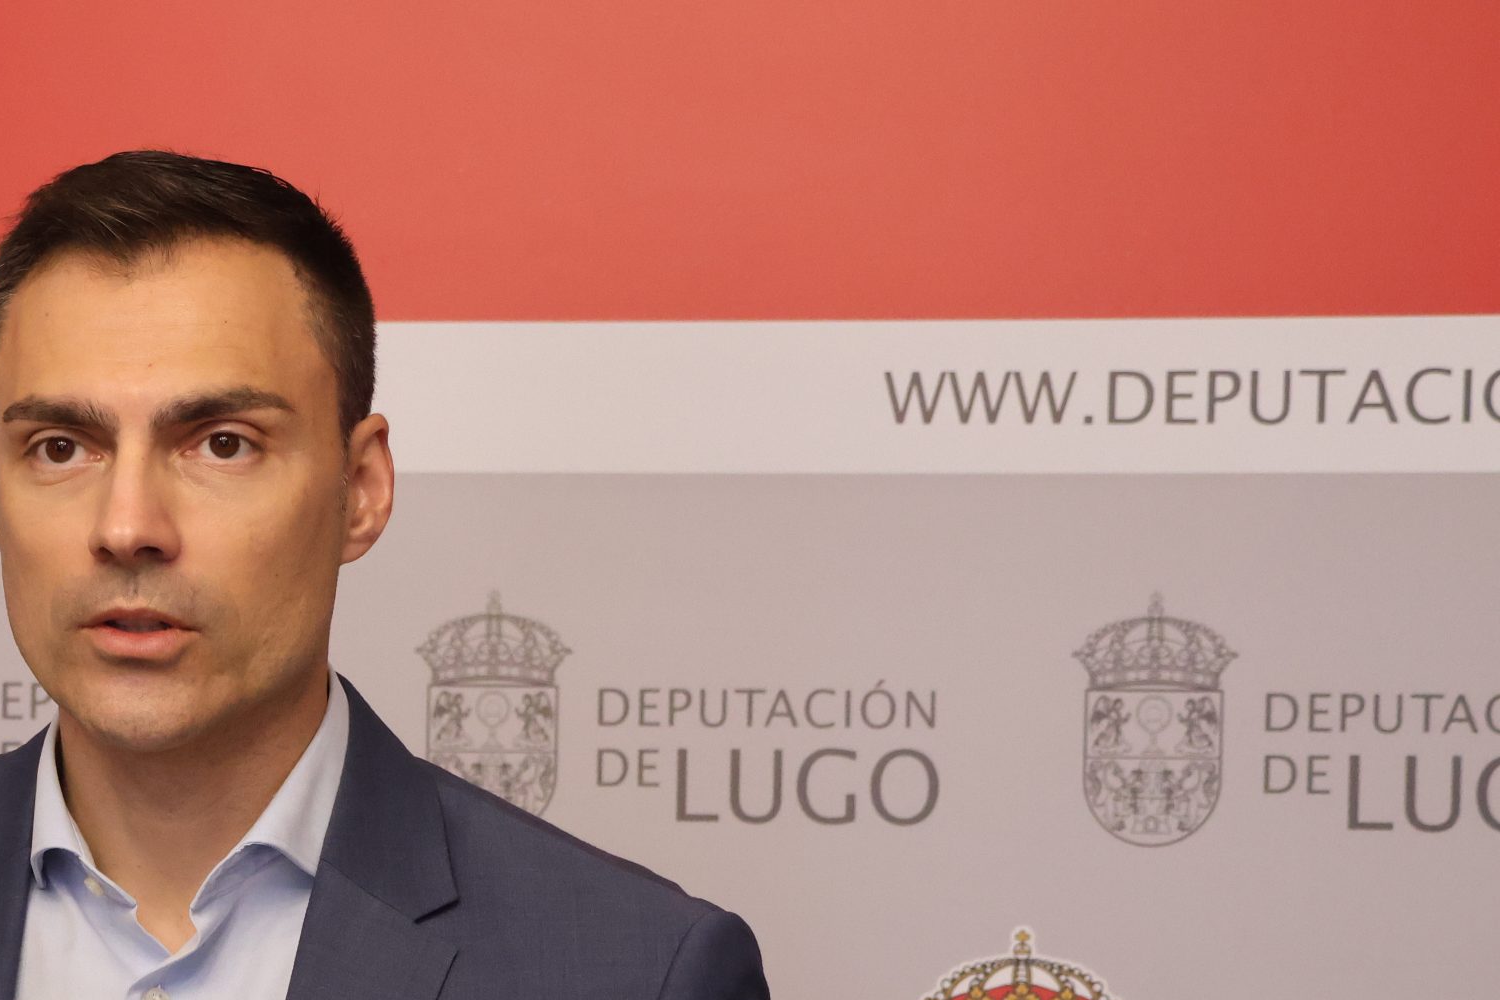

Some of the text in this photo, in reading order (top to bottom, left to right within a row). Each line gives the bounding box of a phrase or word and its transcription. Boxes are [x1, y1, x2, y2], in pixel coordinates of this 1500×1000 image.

[597, 679, 937, 730] DEPUTACIÓN
[596, 747, 940, 827] DE LUGO
[1263, 754, 1330, 795] DE
